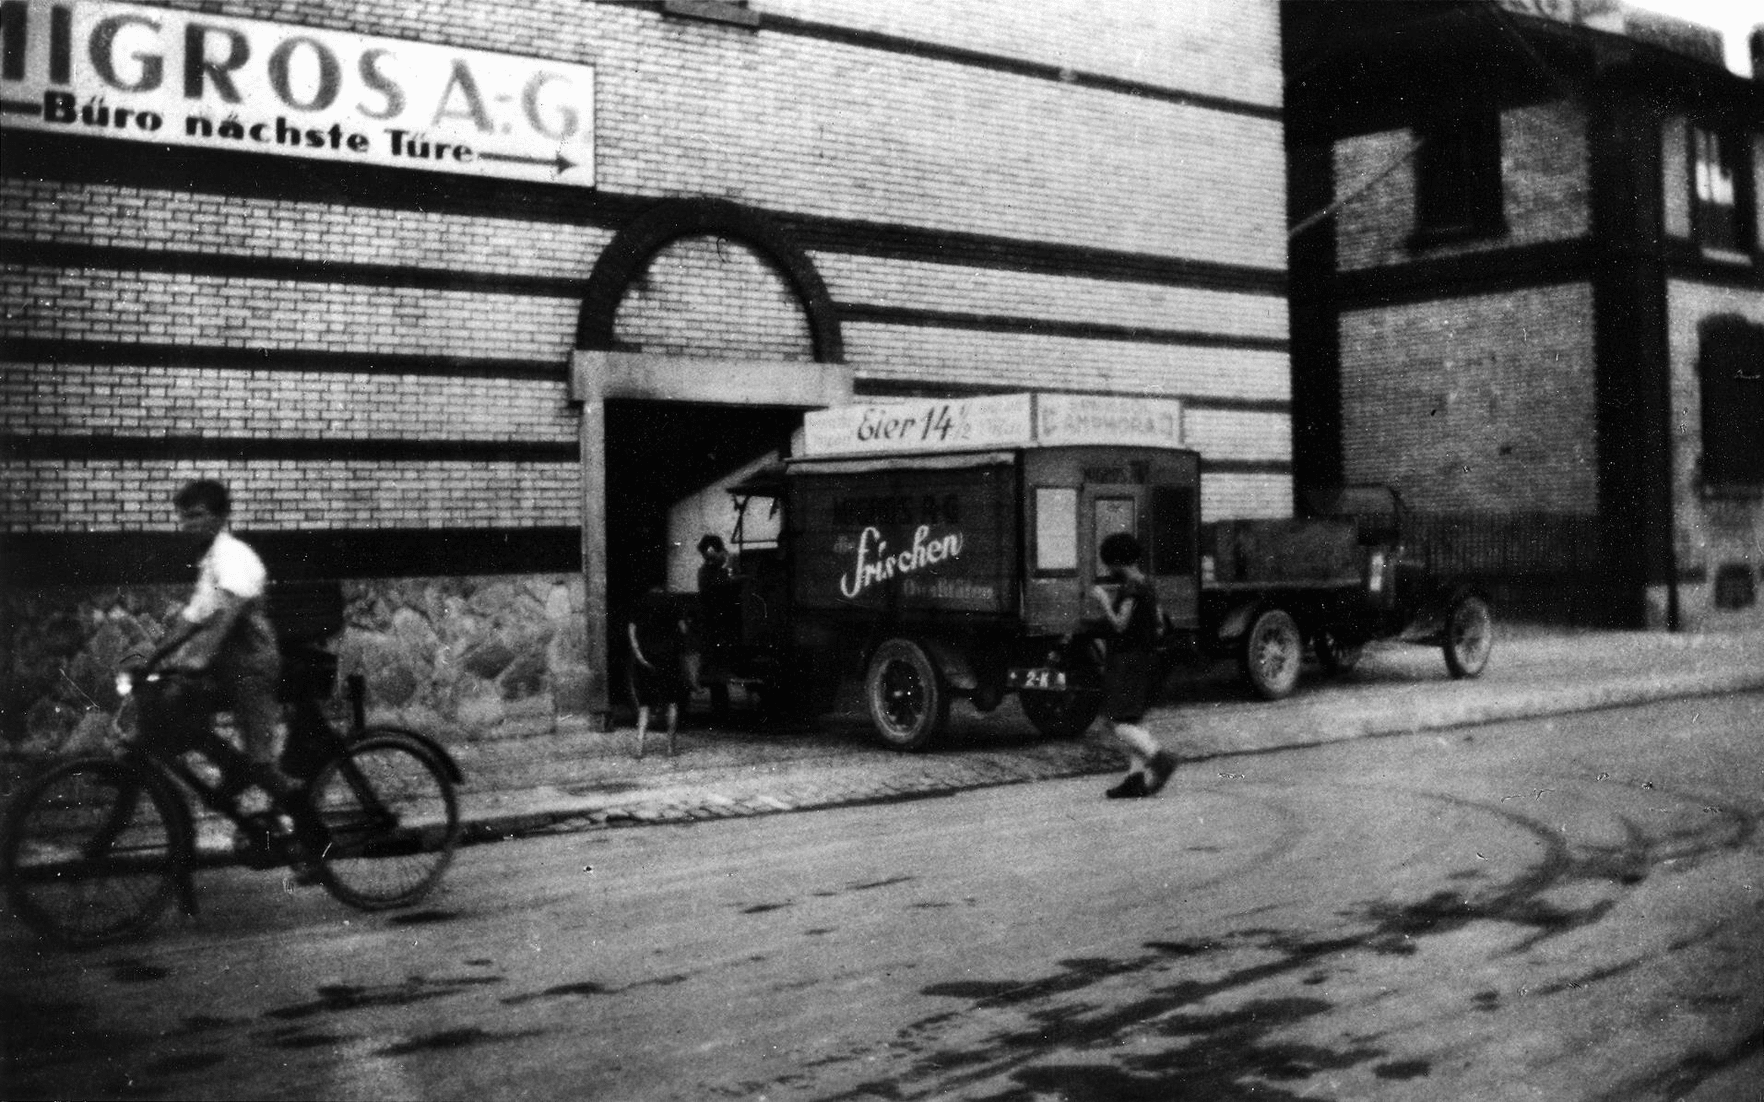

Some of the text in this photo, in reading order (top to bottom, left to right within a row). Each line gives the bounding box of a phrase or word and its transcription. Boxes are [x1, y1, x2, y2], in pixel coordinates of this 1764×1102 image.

[44, 90, 474, 162] Büro nächste Türe
[857, 407, 915, 441] Eier
